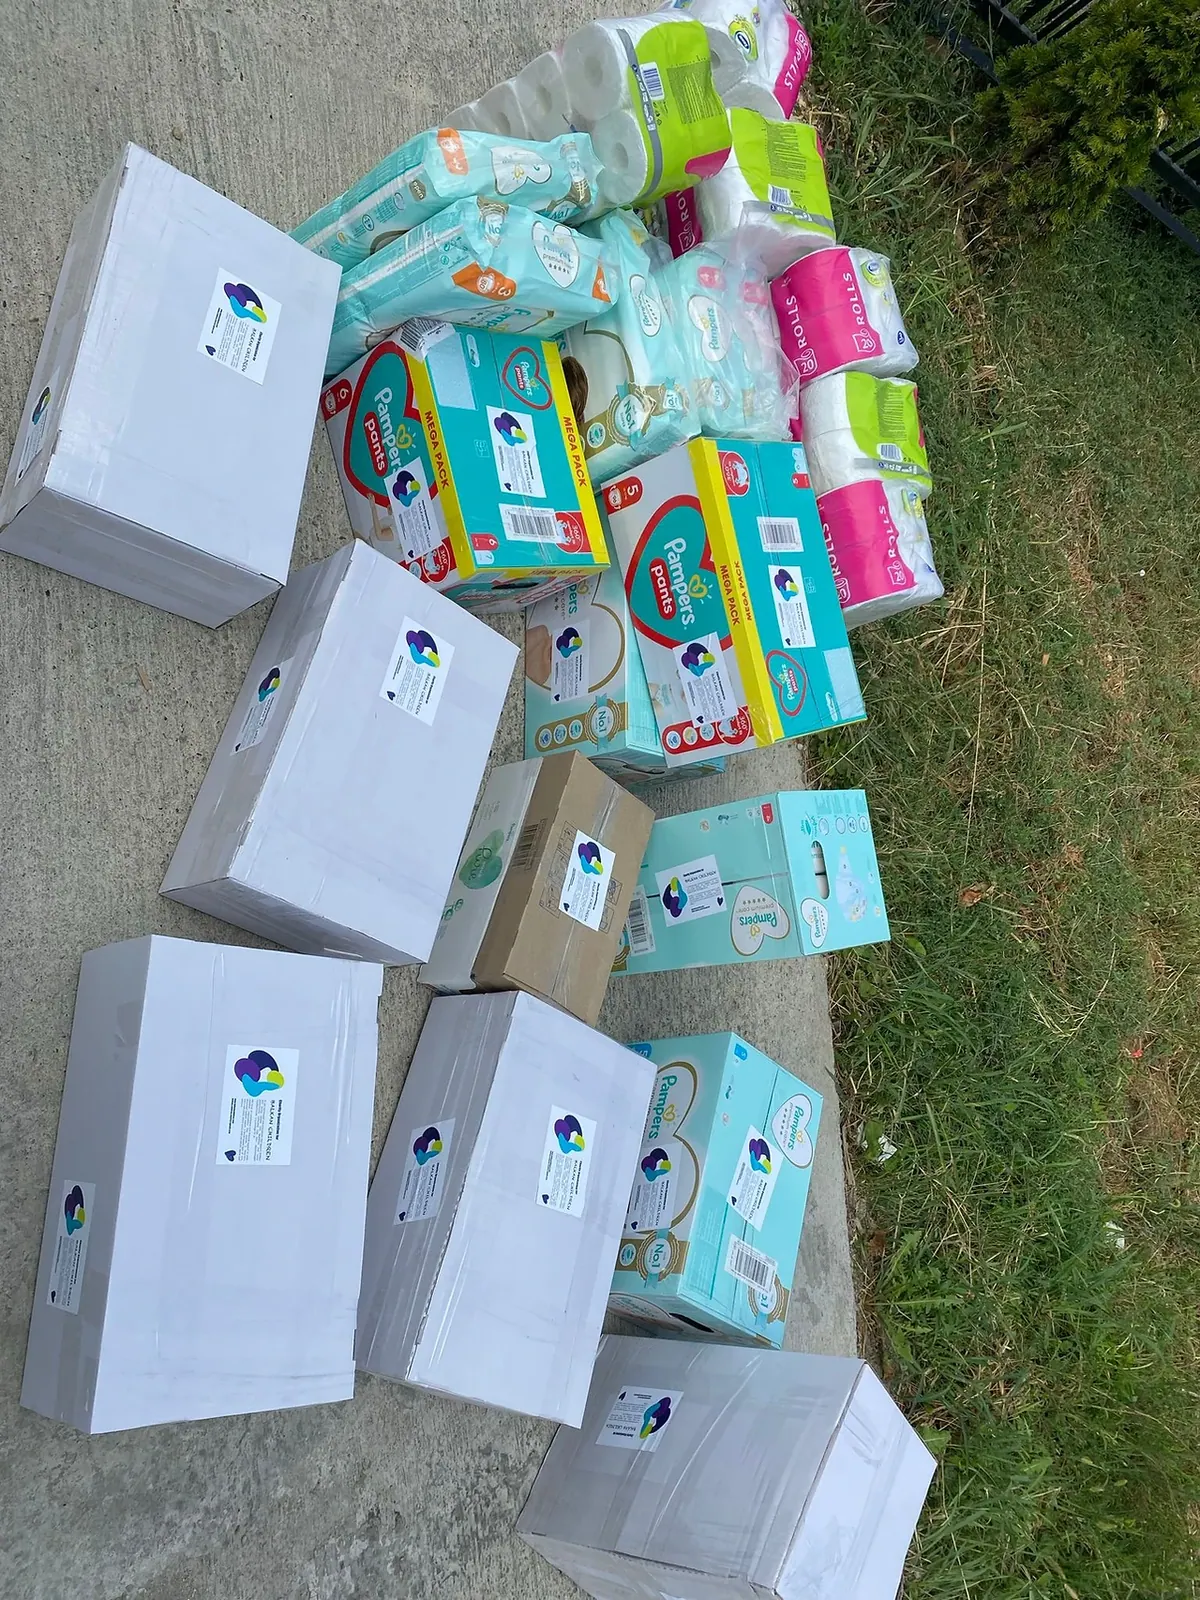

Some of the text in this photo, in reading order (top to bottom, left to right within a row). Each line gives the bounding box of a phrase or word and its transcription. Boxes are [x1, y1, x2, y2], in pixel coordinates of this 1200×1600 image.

[412, 181, 424, 199] open
[498, 287, 512, 296] 3
[843, 273, 864, 325] ROLLS
[706, 307, 720, 350] Pampers
[786, 295, 807, 349] ROLLS
[339, 388, 349, 399] 6
[514, 367, 524, 389] pants
[521, 361, 534, 396] Pampers
[374, 387, 402, 474] Pamper
[622, 400, 636, 429] No.1
[364, 418, 386, 470] pants
[424, 410, 449, 490] MEGA PACK
[562, 416, 588, 487] MEGA PACK
[627, 484, 638, 496] 5
[489, 538, 496, 546] 6
[878, 506, 895, 558] ROLLS
[651, 564, 673, 614] pants
[664, 538, 696, 625] Pampers
[720, 565, 740, 625] MEGA PACK
[734, 561, 752, 621] MEGA PACK
[782, 664, 794, 699] Pampers
[598, 710, 607, 732] No.1
[739, 912, 777, 927] Pampers
[812, 906, 821, 938] Pampers
[648, 1075, 678, 1139] Pampers
[788, 1106, 804, 1150] Pampers
[652, 1244, 664, 1268] No.1
